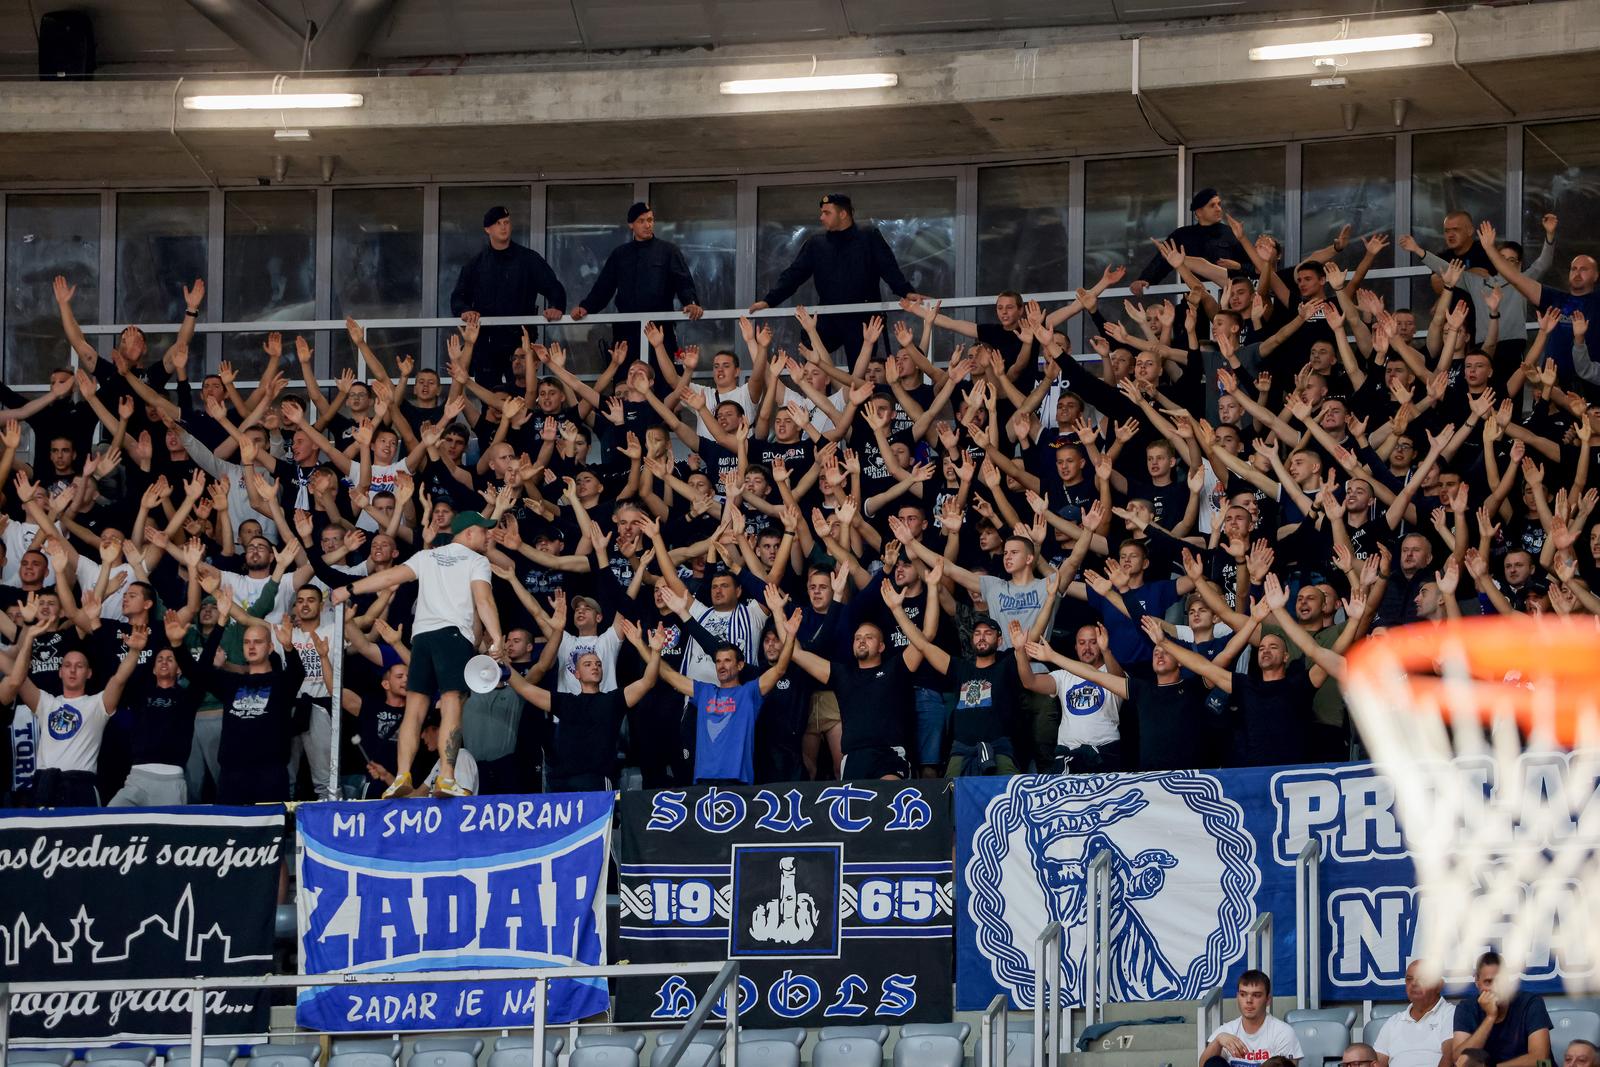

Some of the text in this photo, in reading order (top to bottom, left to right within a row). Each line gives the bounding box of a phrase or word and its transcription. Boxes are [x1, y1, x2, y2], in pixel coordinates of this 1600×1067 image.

[646, 783, 932, 833] SOUTH
[1034, 774, 1120, 809] TORNADO
[332, 799, 583, 838] MI SMO ZADRANI
[1042, 811, 1101, 840] ZADAR
[156, 836, 282, 878] sanjari
[302, 836, 602, 975] ZADAR
[650, 878, 715, 925] 19
[857, 876, 937, 923] 65
[347, 984, 552, 1024] ZADAR JE NA
